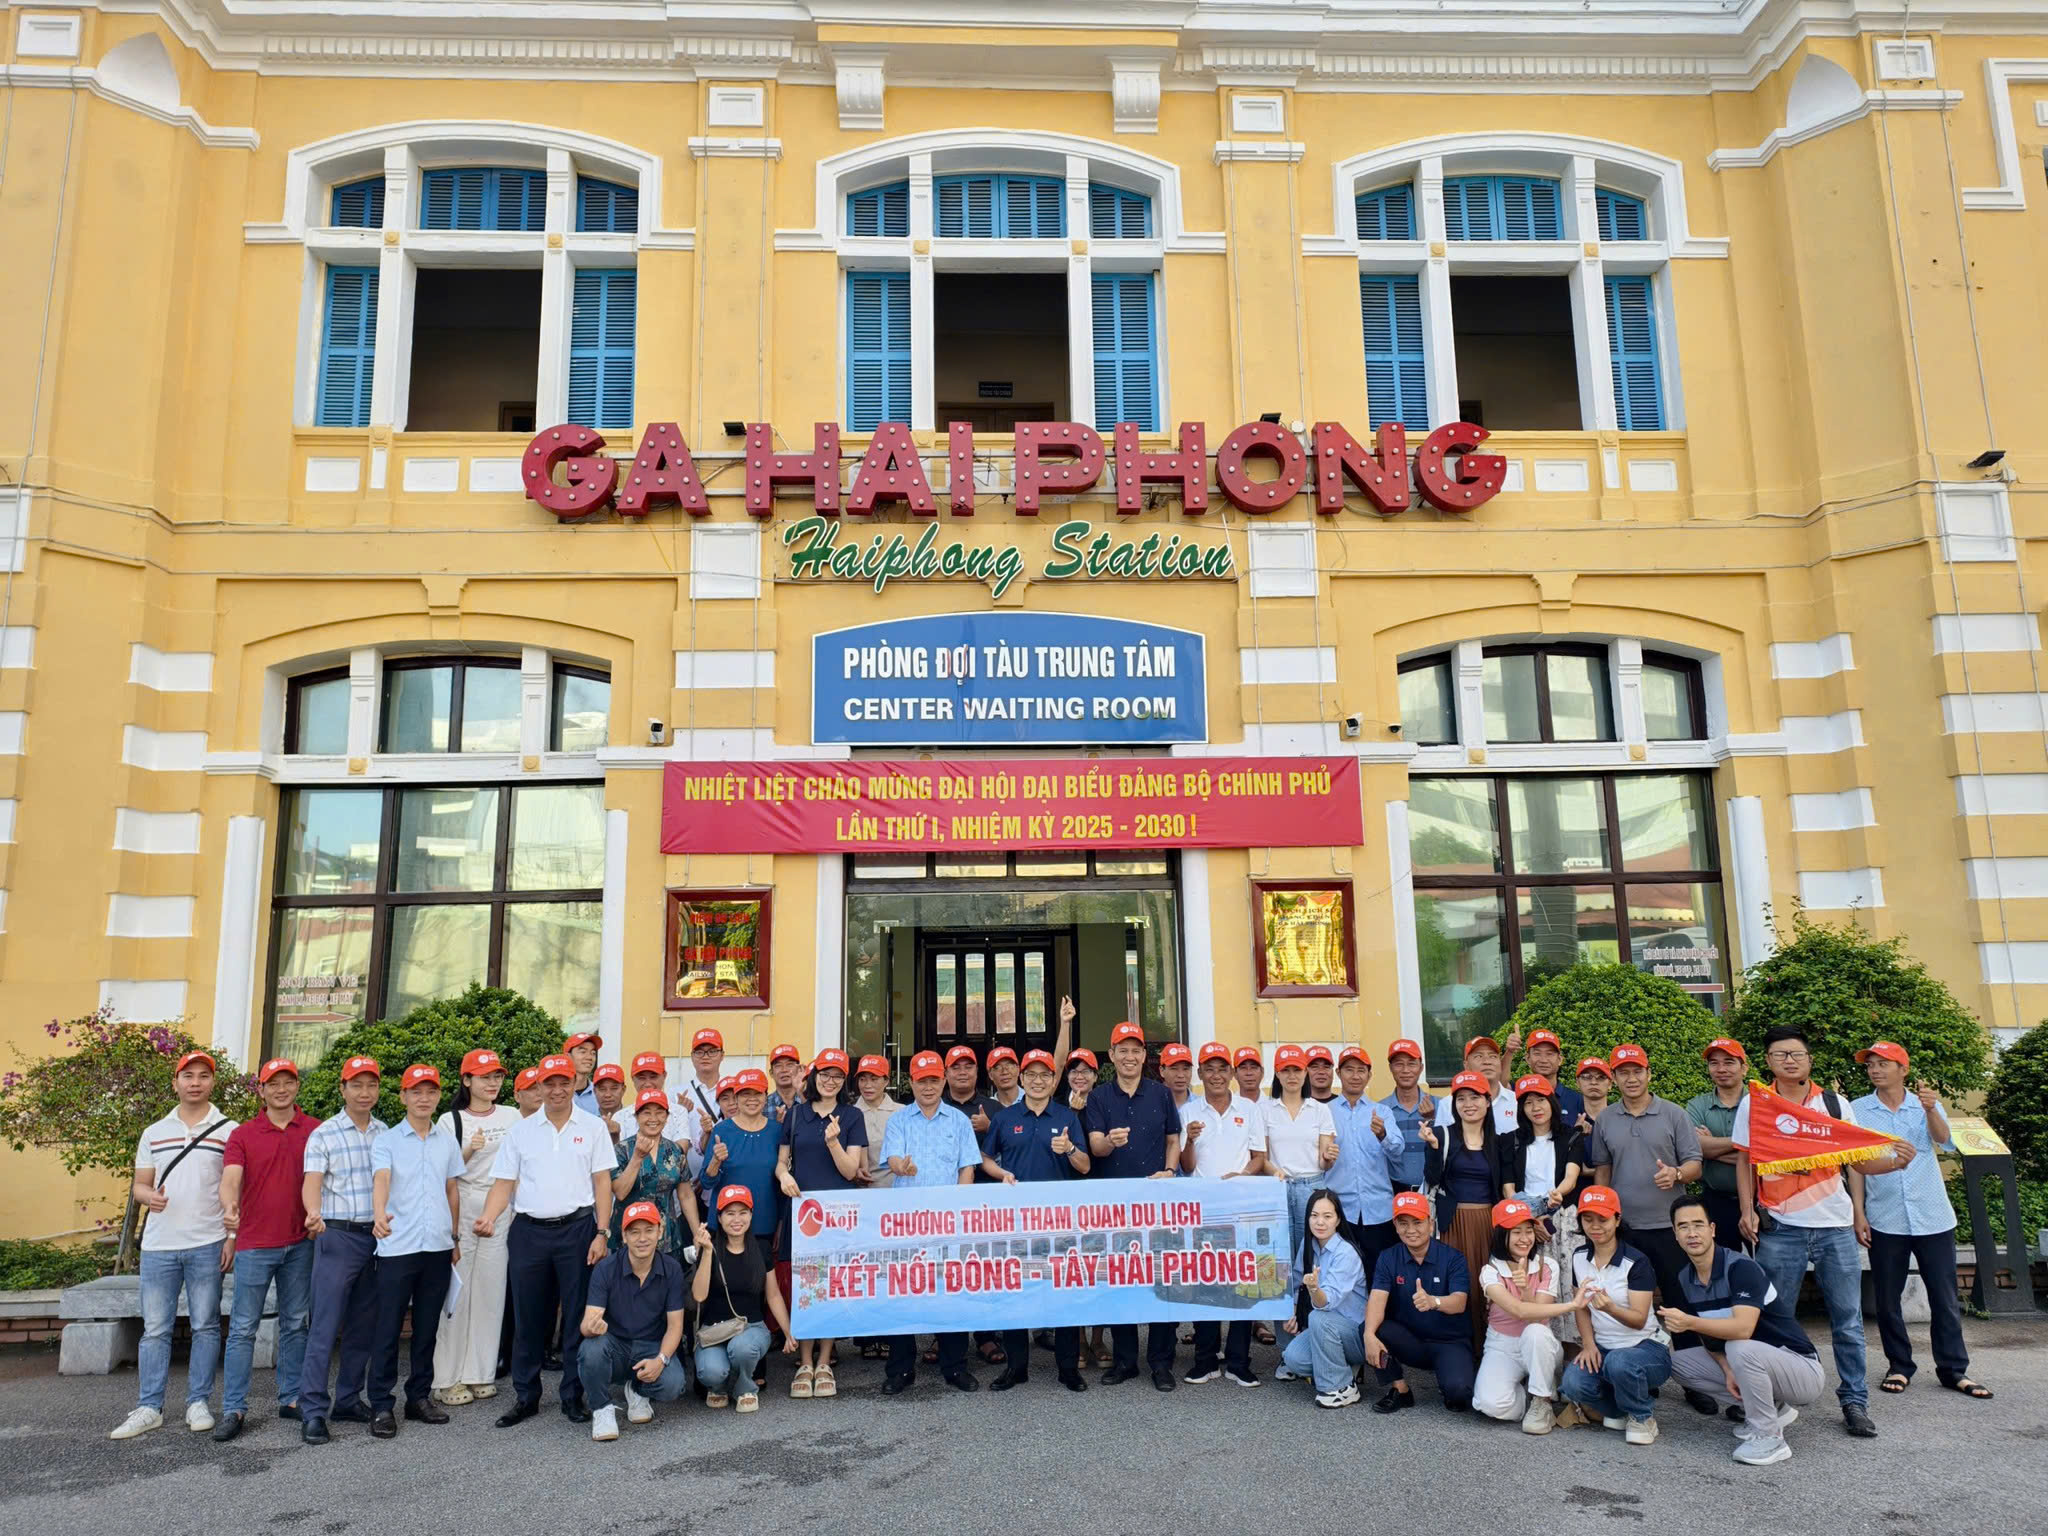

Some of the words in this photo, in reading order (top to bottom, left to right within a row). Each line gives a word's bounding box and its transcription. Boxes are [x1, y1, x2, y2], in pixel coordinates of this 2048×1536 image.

[522, 422, 713, 518] GA
[745, 421, 975, 517] HAI
[1014, 421, 1507, 515] PHONG
[783, 516, 1024, 598] Haiphong
[1043, 519, 1235, 578] Station
[843, 639, 928, 679] PHÒNG
[935, 643, 976, 685] ĐỢI
[983, 639, 1029, 678] TÀU
[1034, 646, 1115, 678] TRUNG
[1122, 639, 1176, 678] TÂM
[843, 697, 954, 721] CENTER
[963, 697, 1085, 720] WAITING
[1092, 696, 1177, 720] ROOM
[684, 771, 748, 806] NHIỆT
[753, 771, 798, 806] LIỆT
[803, 772, 862, 801] CHÀO
[867, 771, 933, 801] MỪNG
[938, 775, 974, 805] ĐẠI
[981, 770, 1017, 804] HỘI
[1022, 775, 1058, 803] ĐẠI
[1064, 764, 1113, 798] BIỂU
[1118, 766, 1177, 798] ĐẢNG
[1183, 768, 1211, 801] BỘ
[1217, 768, 1283, 796] CHÍNH
[1288, 763, 1331, 796] PHỦ
[836, 808, 878, 842] LẦN
[884, 811, 928, 842] THỨ
[951, 810, 1022, 845] NHIỆM
[1028, 810, 1056, 840] KỲ
[1062, 814, 1113, 839] 2025
[1134, 813, 1186, 838] 2030
[1802, 1123, 1831, 1137] Koji
[825, 1209, 858, 1232] Koji
[880, 1208, 955, 1237] CHƯƠNG
[961, 1203, 1015, 1234] TRÌNH
[1020, 1205, 1072, 1232] THAM
[1077, 1203, 1126, 1232] QUAN
[1131, 1203, 1156, 1227] DU
[1161, 1202, 1201, 1232] LỊCH
[828, 1253, 880, 1298] KẾT
[887, 1249, 936, 1296] NỐI
[944, 1253, 1022, 1293] ĐÔNG
[1030, 1270, 1041, 1280] -
[1049, 1249, 1099, 1288] TÂY
[1107, 1242, 1154, 1286] HẢI
[1162, 1243, 1257, 1285] PHÒNG
